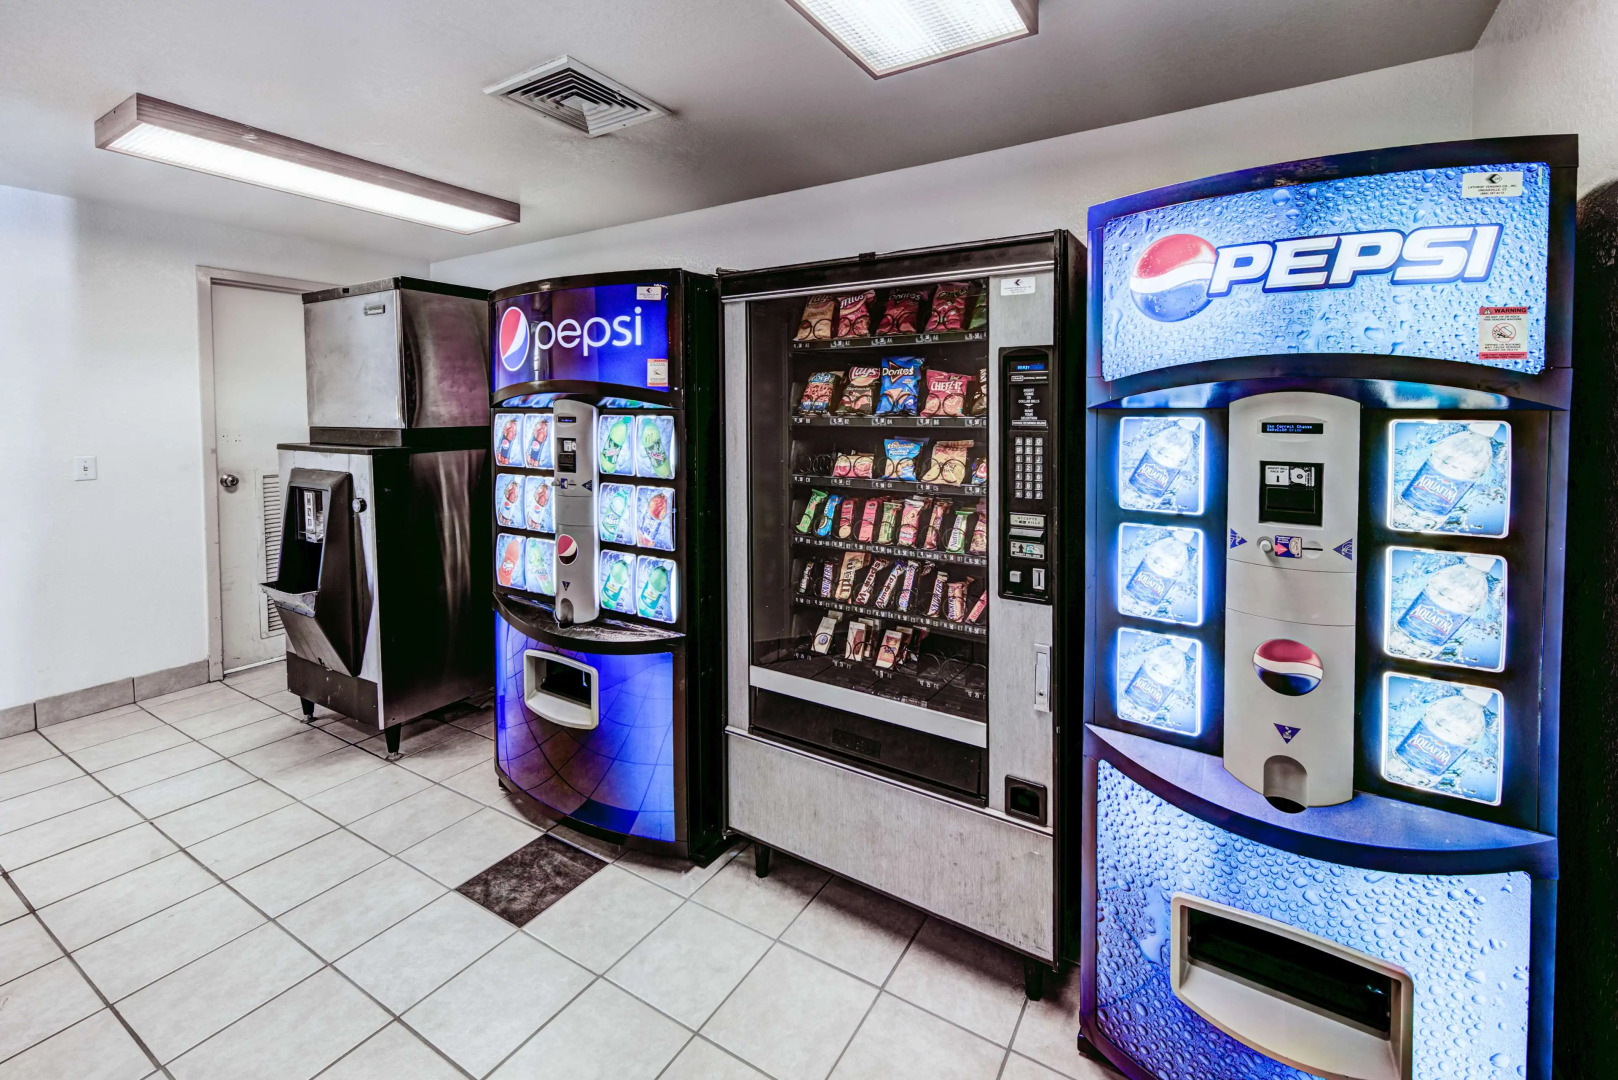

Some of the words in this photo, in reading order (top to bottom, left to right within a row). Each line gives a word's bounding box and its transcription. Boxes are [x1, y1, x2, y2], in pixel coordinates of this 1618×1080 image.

[1208, 223, 1503, 297] PEPSI
[534, 306, 643, 358] pepsi
[882, 366, 915, 377] Doritos
[876, 578, 894, 608] Almond
[930, 577, 944, 614] SNICKERS
